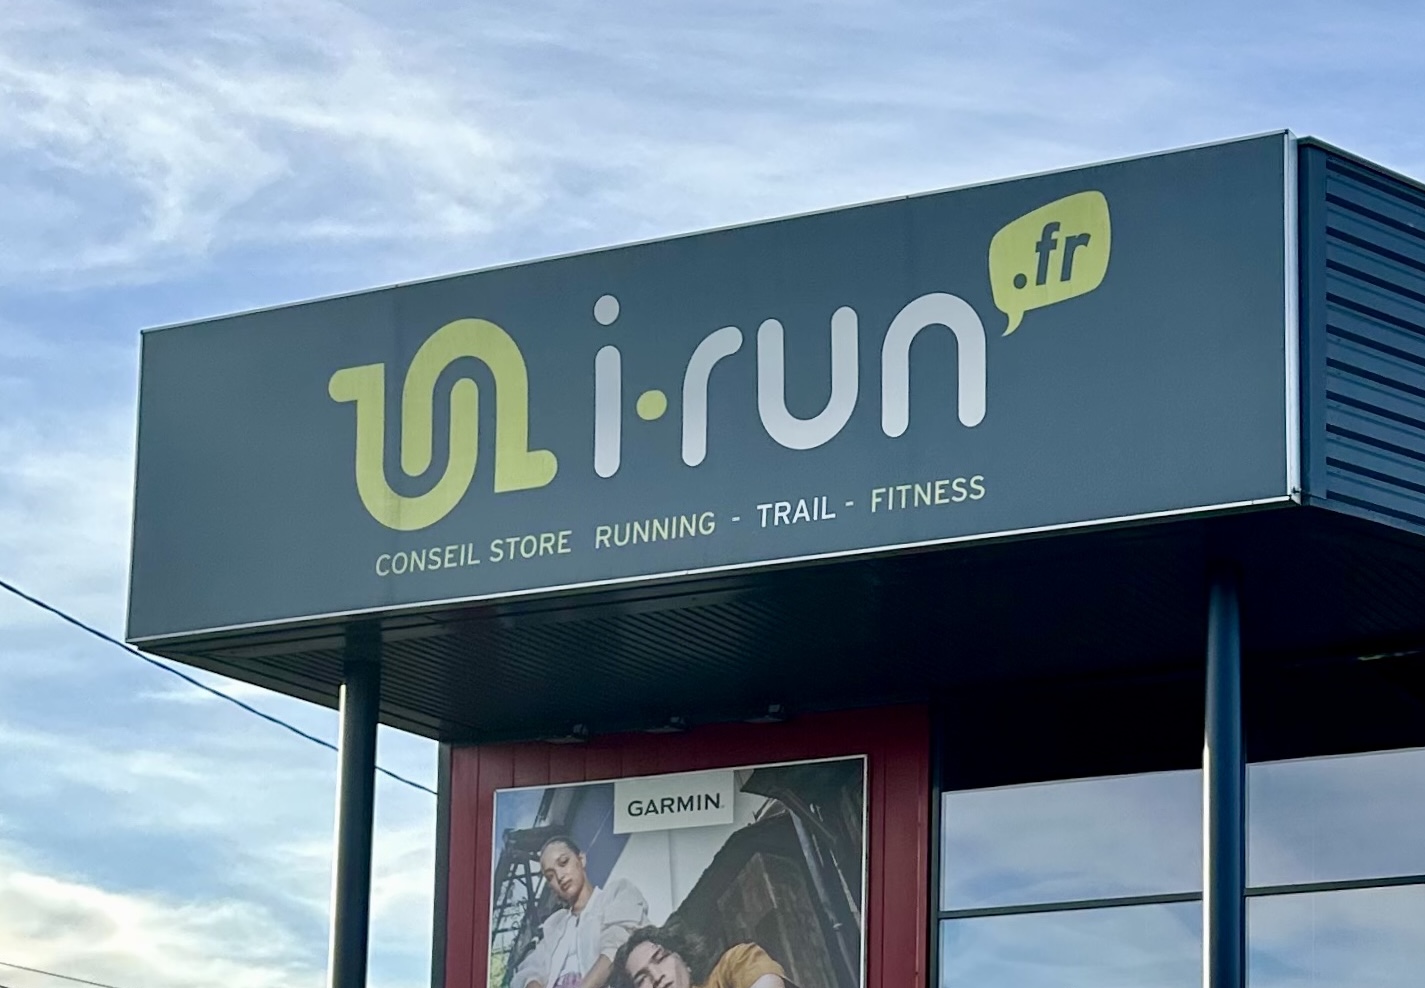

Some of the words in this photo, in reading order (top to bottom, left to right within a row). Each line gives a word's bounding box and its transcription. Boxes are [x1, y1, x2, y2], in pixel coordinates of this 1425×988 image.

[374, 543, 481, 578] CONSEIL
[489, 530, 573, 563] STORE
[595, 511, 717, 550] RUNNING
[757, 494, 837, 529] TRAIL
[871, 474, 986, 514] FITNESS
[627, 792, 721, 818] GARMIN
